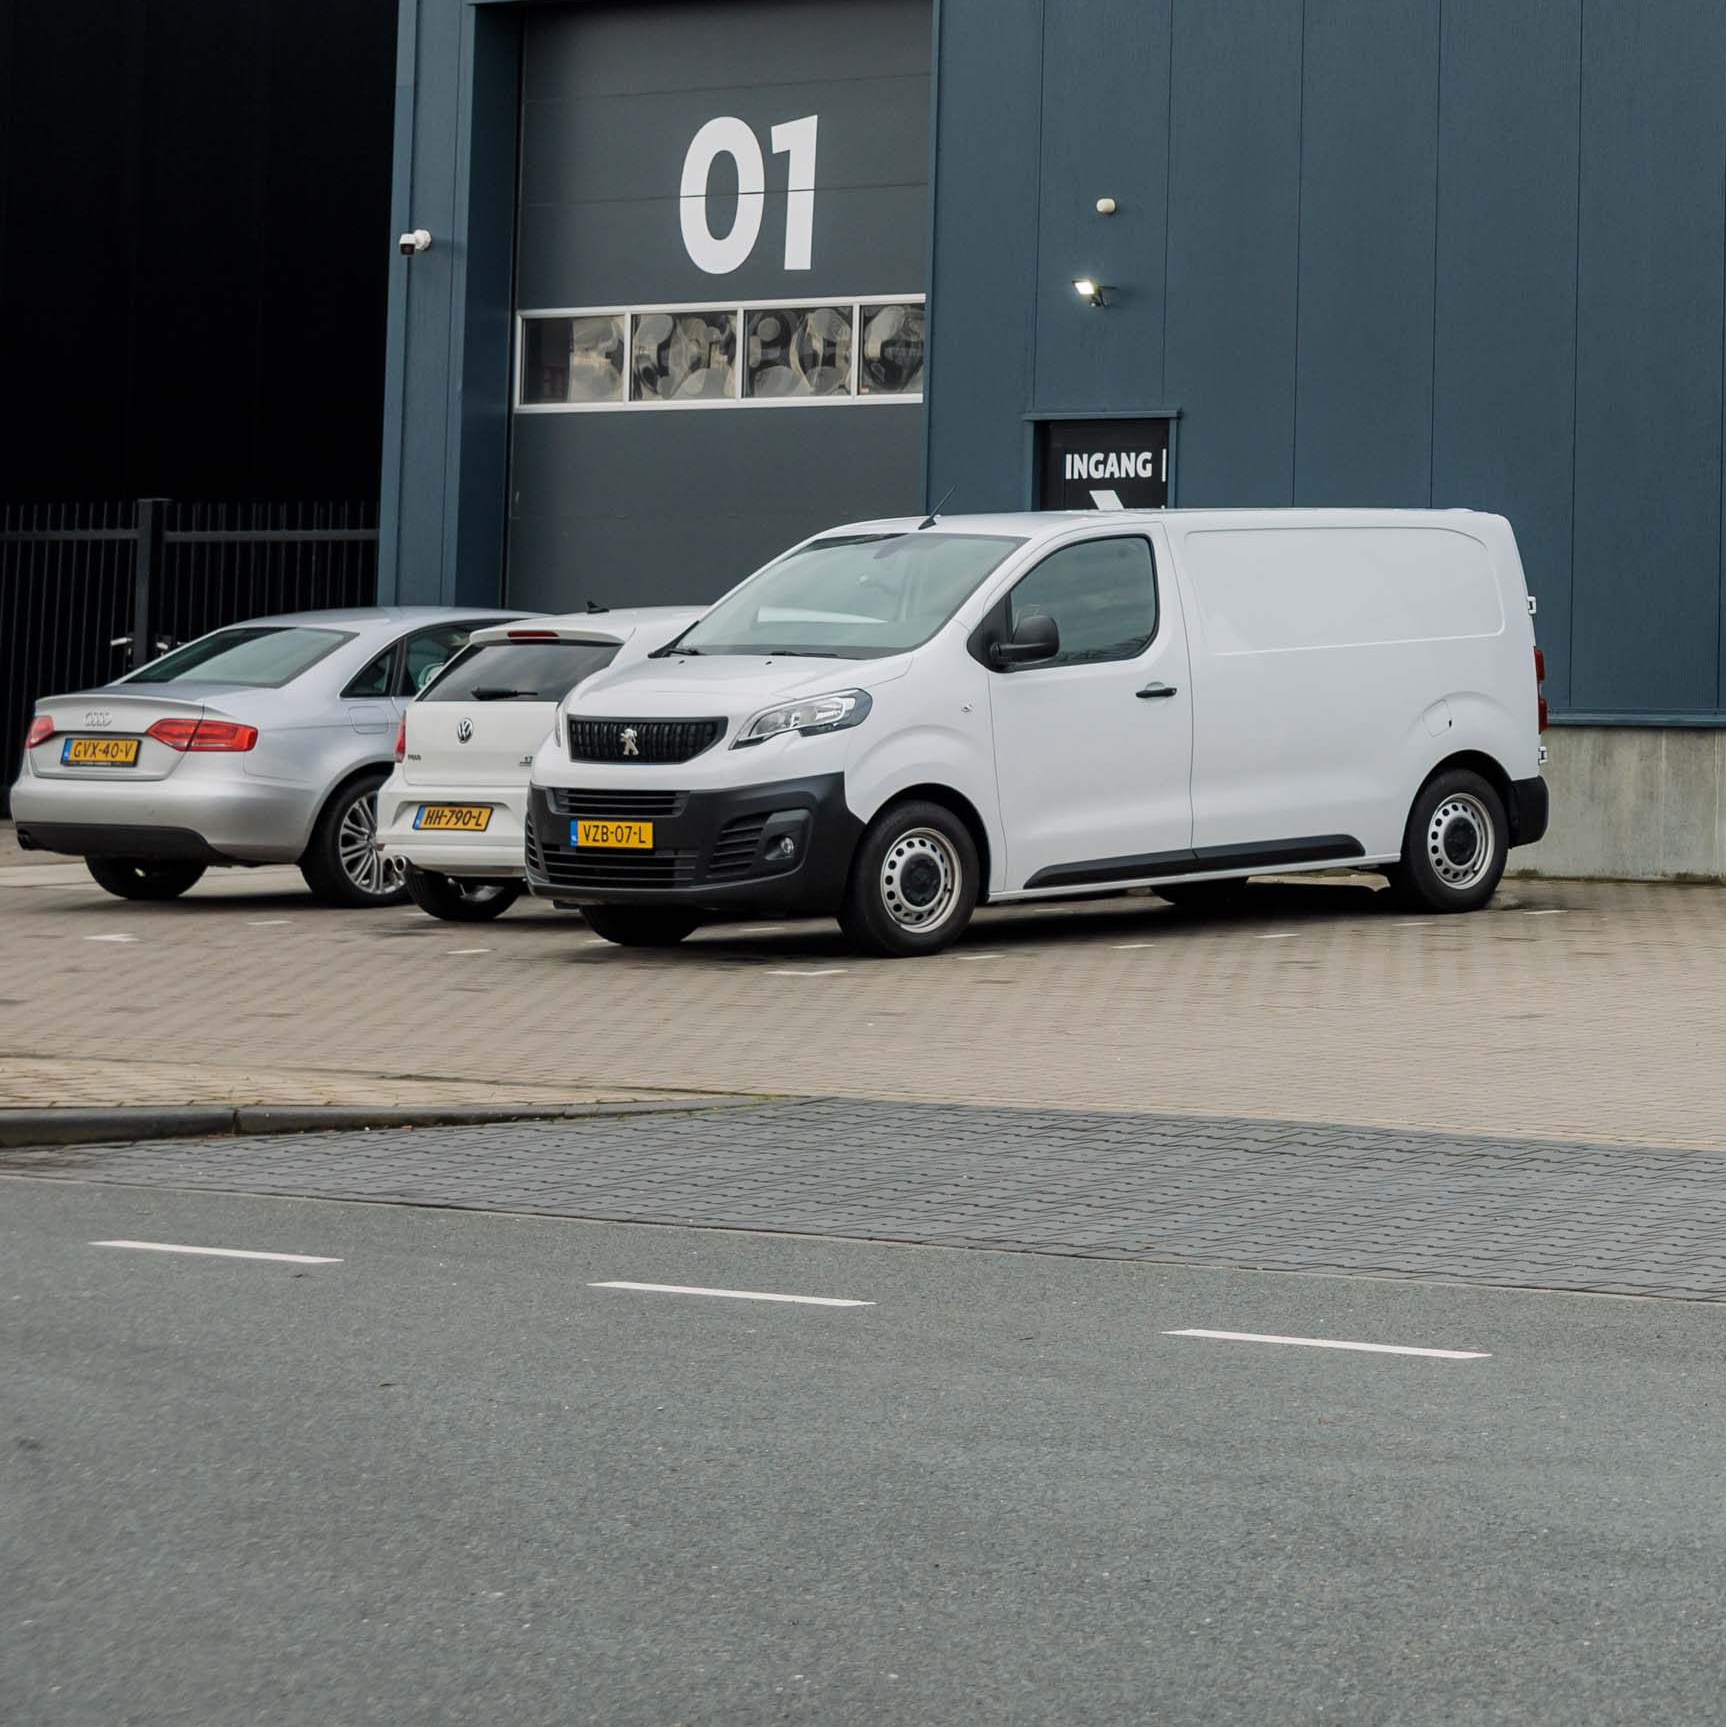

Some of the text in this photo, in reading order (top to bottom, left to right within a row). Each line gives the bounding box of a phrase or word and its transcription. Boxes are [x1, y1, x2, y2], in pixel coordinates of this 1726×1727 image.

[679, 114, 818, 275] 01
[1065, 451, 1153, 480] INGANG
[74, 742, 133, 759] GVX-40-V
[424, 809, 483, 827] HH-790-L
[583, 824, 647, 844] VZB-07-L
